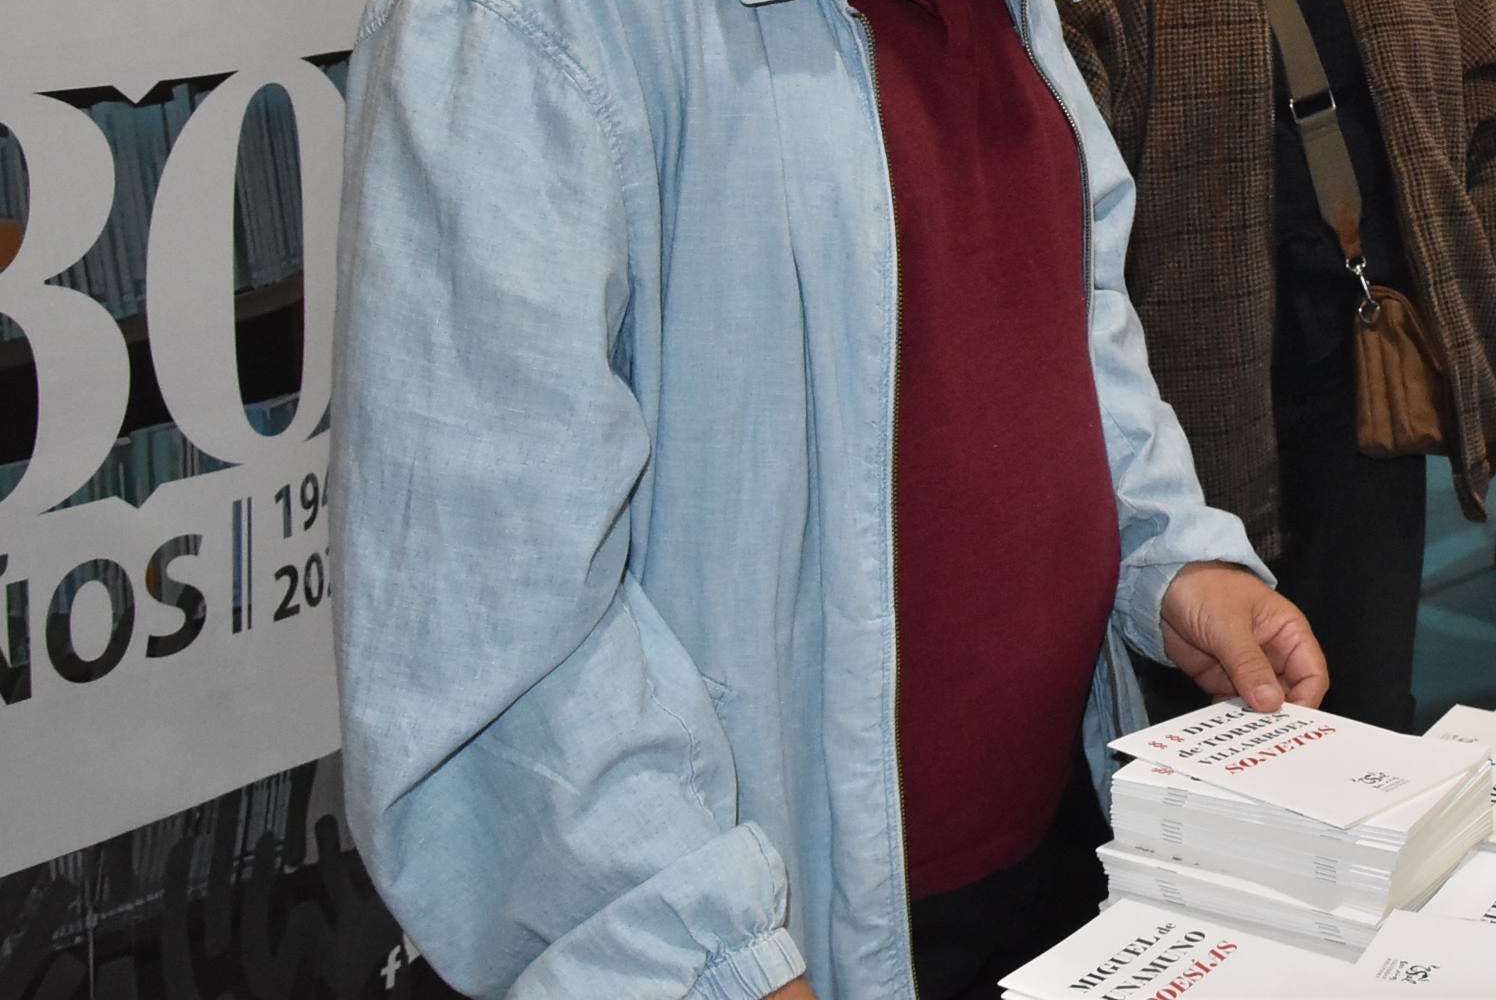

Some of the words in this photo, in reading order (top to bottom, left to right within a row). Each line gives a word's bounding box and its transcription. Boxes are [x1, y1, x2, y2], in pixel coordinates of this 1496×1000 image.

[274, 472, 329, 539] 19
[273, 547, 332, 622] 20
[1177, 745, 1198, 759] de
[1194, 711, 1290, 749] TORRES
[1197, 718, 1315, 766] VILLARROEL
[1225, 724, 1337, 775] SONETOS
[1069, 935, 1161, 994] MIGUEL
[1156, 922, 1177, 936] de
[1146, 940, 1239, 1000] OESÍAS
